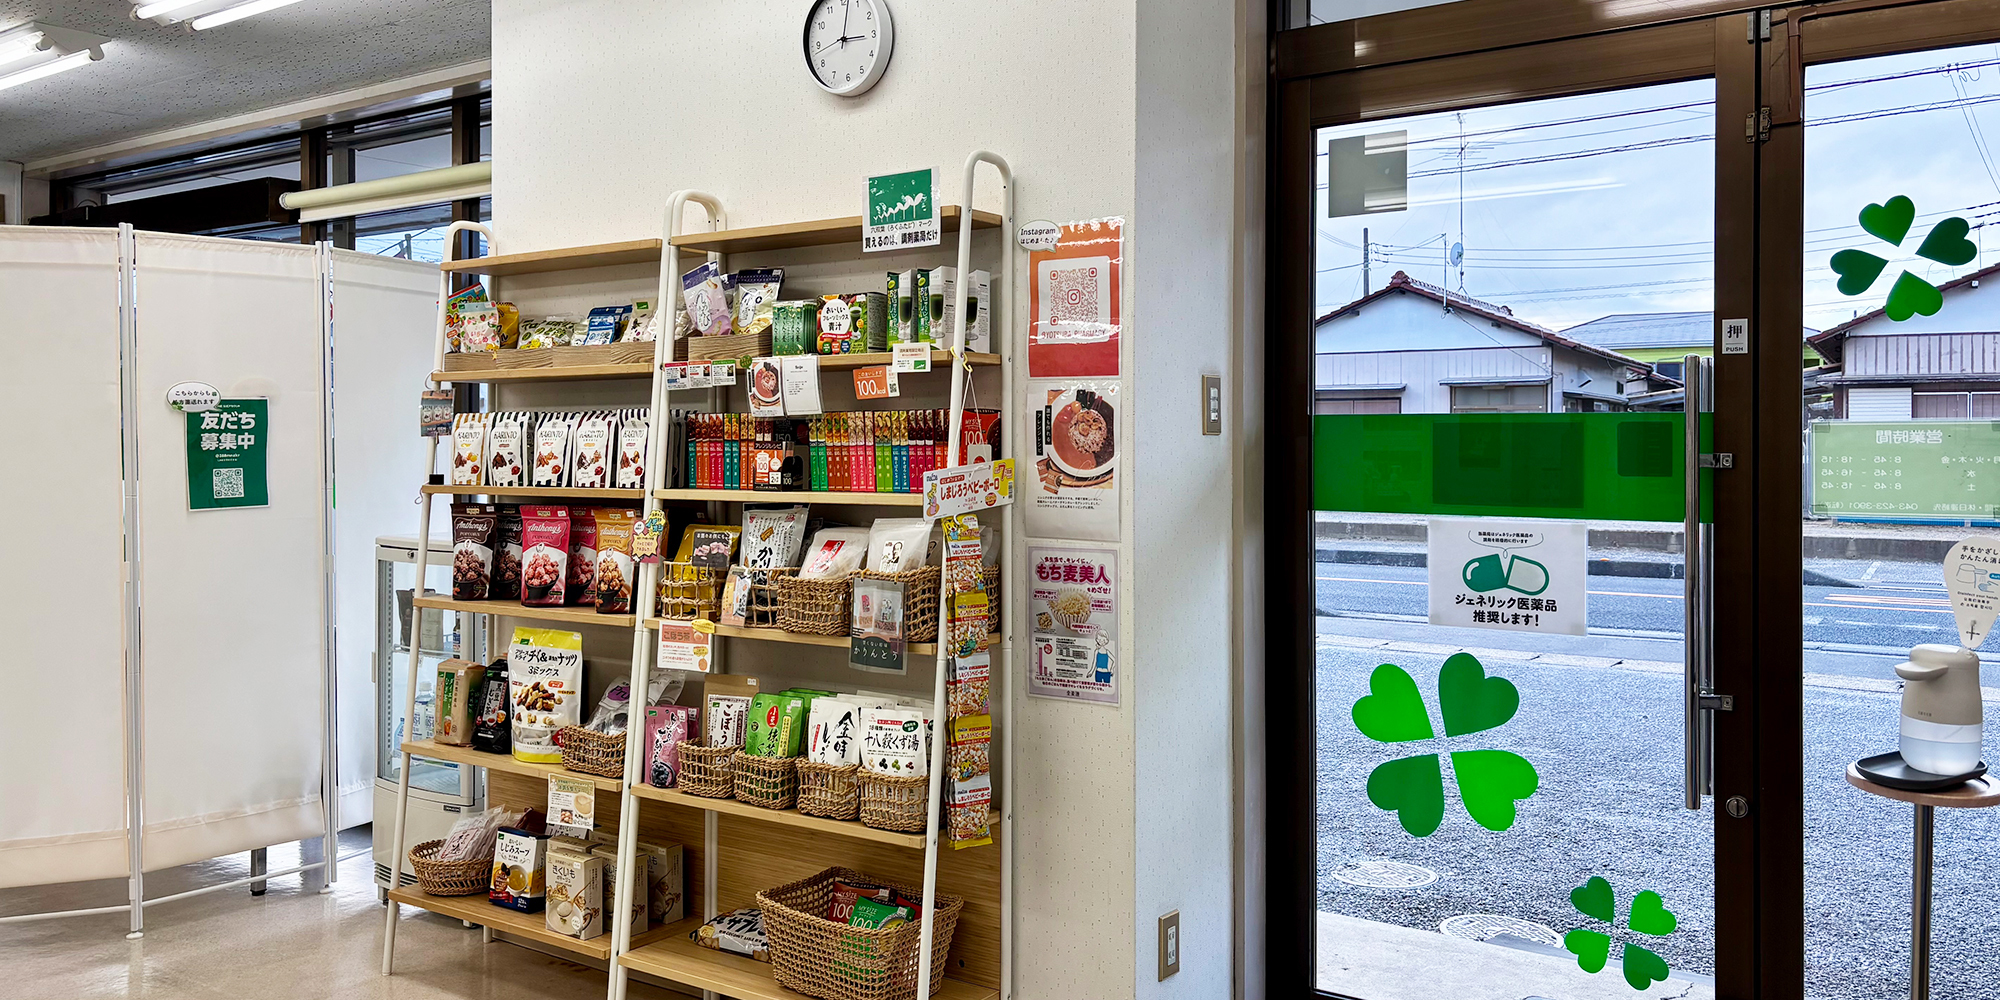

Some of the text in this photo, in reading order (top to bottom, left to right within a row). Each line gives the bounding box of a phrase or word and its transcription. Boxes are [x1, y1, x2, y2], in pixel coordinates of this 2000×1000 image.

[827, 6, 833, 14] 11
[867, 12, 871, 20] 2
[818, 22, 825, 30] 10
[871, 30, 876, 38] 3
[816, 41, 821, 50] 9
[869, 50, 874, 58] 4
[820, 59, 826, 67] 8
[831, 71, 836, 79] 7
[859, 66, 865, 74] 5
[845, 74, 851, 82] 6
[1020, 228, 1055, 236] Instagram
[1727, 324, 1742, 338] 押
[200, 411, 255, 430] 友だち
[200, 432, 255, 450] 募集中
[941, 478, 999, 501] しまじろうベビーボーロ
[457, 521, 489, 532] Anthony's
[528, 524, 562, 534] Anthony's
[600, 528, 630, 539] Anthony's
[1961, 545, 2000, 556] 手をかざし
[1037, 563, 1110, 584] もち麦美人
[1455, 594, 1557, 612] ジェネリック医薬品
[1473, 610, 1540, 626] 推奨します!
[663, 631, 690, 641] ごぼう茶
[558, 652, 578, 666] ナッツ
[853, 646, 899, 661] かりんとう
[528, 665, 559, 676] 3ミックス
[834, 711, 856, 759] 金時
[864, 732, 920, 751] 十八穀くず湯
[500, 843, 531, 856] しじみスープ
